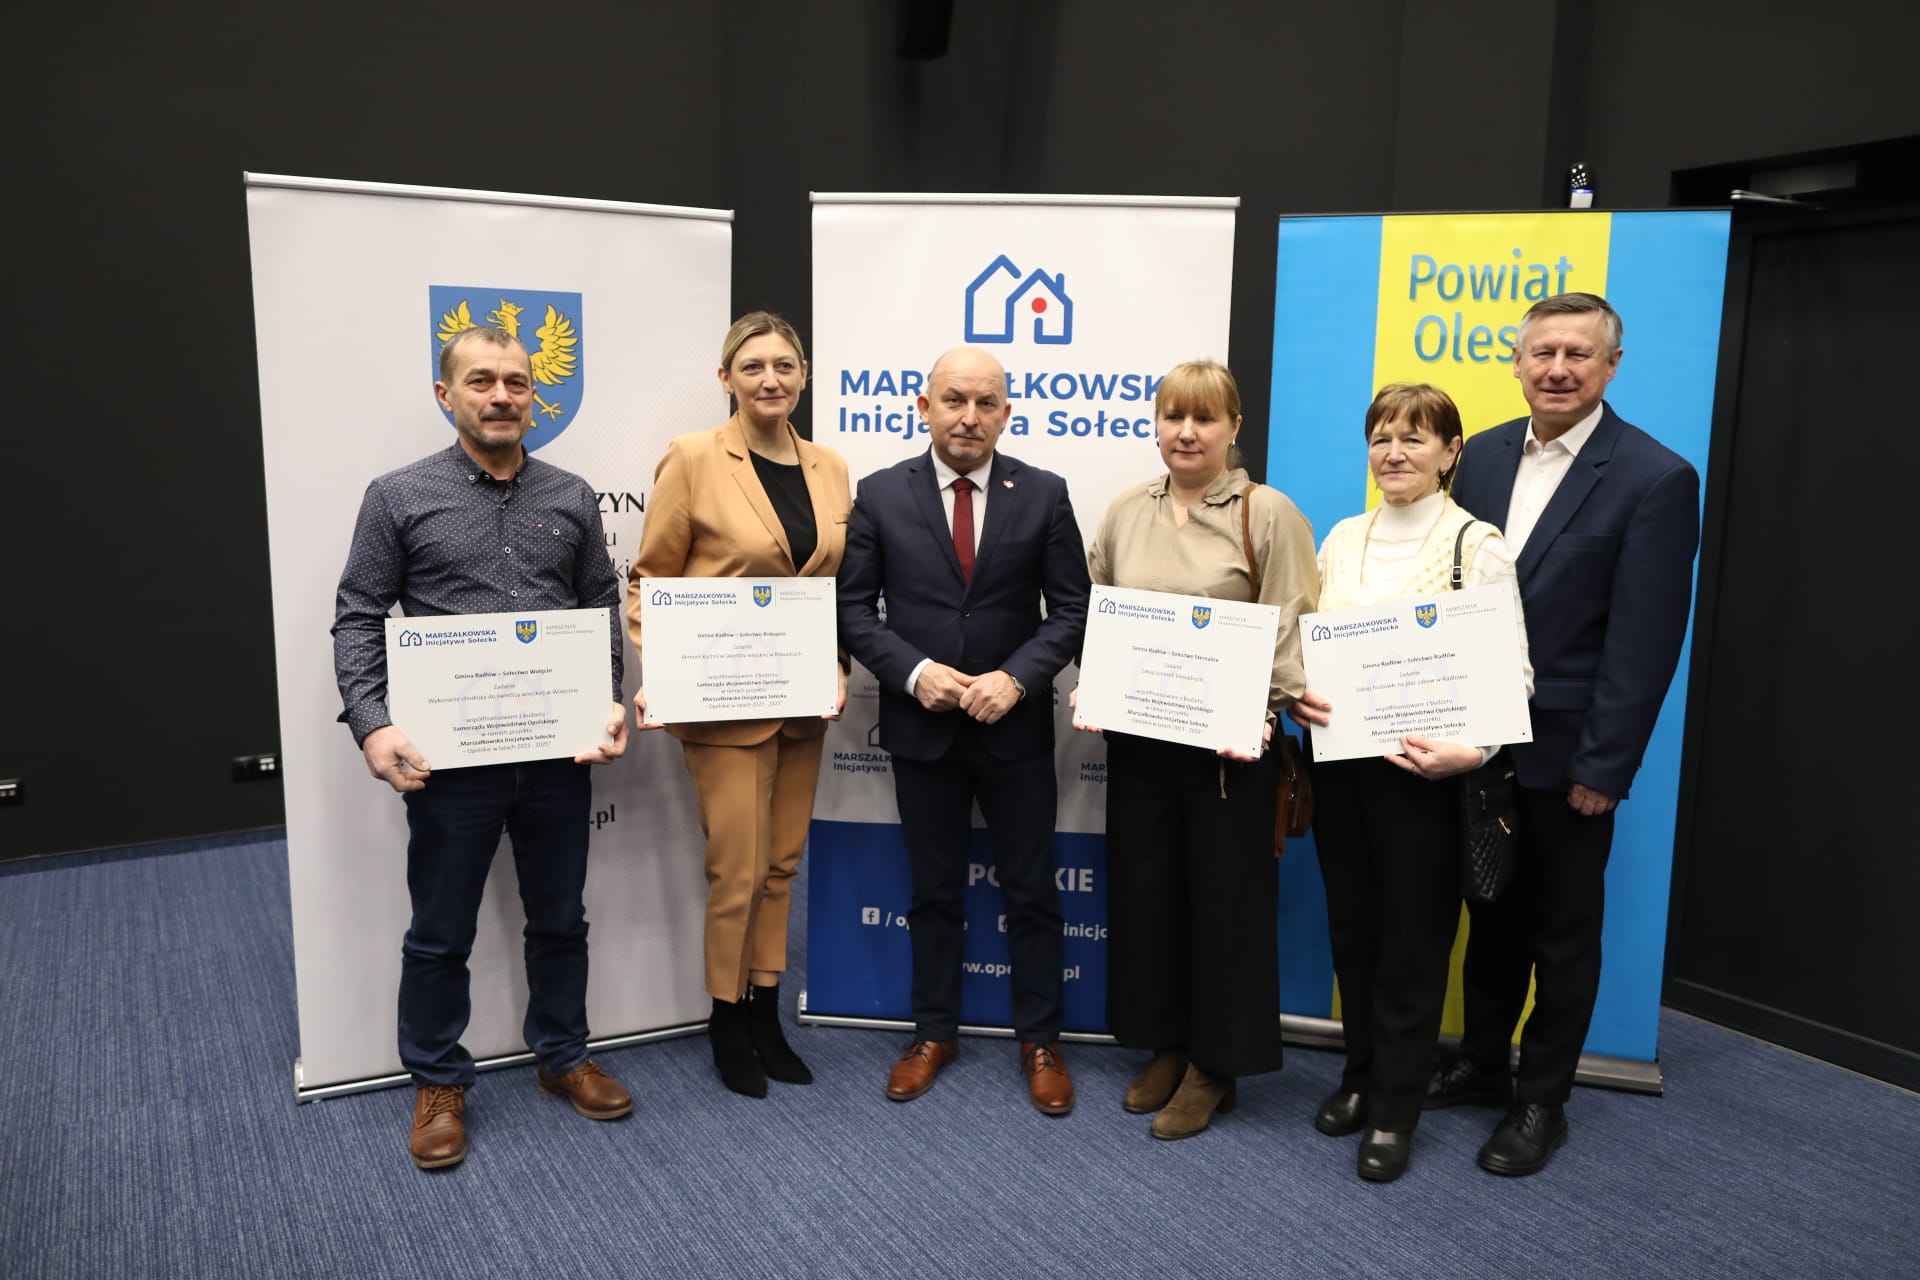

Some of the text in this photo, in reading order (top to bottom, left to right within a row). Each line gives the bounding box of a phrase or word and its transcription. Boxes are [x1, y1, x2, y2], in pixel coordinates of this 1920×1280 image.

[1409, 248, 1573, 301] Powiat
[1414, 312, 1519, 362] Oles
[840, 370, 1166, 402] MARŁKOWSK
[839, 405, 1157, 440] Inicja Sołec
[1117, 610, 1175, 622] Inicjatywa Sołecka
[1119, 603, 1176, 616] MARSZAŁKOWSKA
[1333, 617, 1398, 632] MARSZAŁKOWSKA
[1334, 624, 1399, 639] Inicjatywa Sołecka
[425, 629, 496, 639] MARSZAŁKOWSKA
[425, 638, 464, 646] Inicjatywa
[833, 763, 887, 773] Inicjatywa
